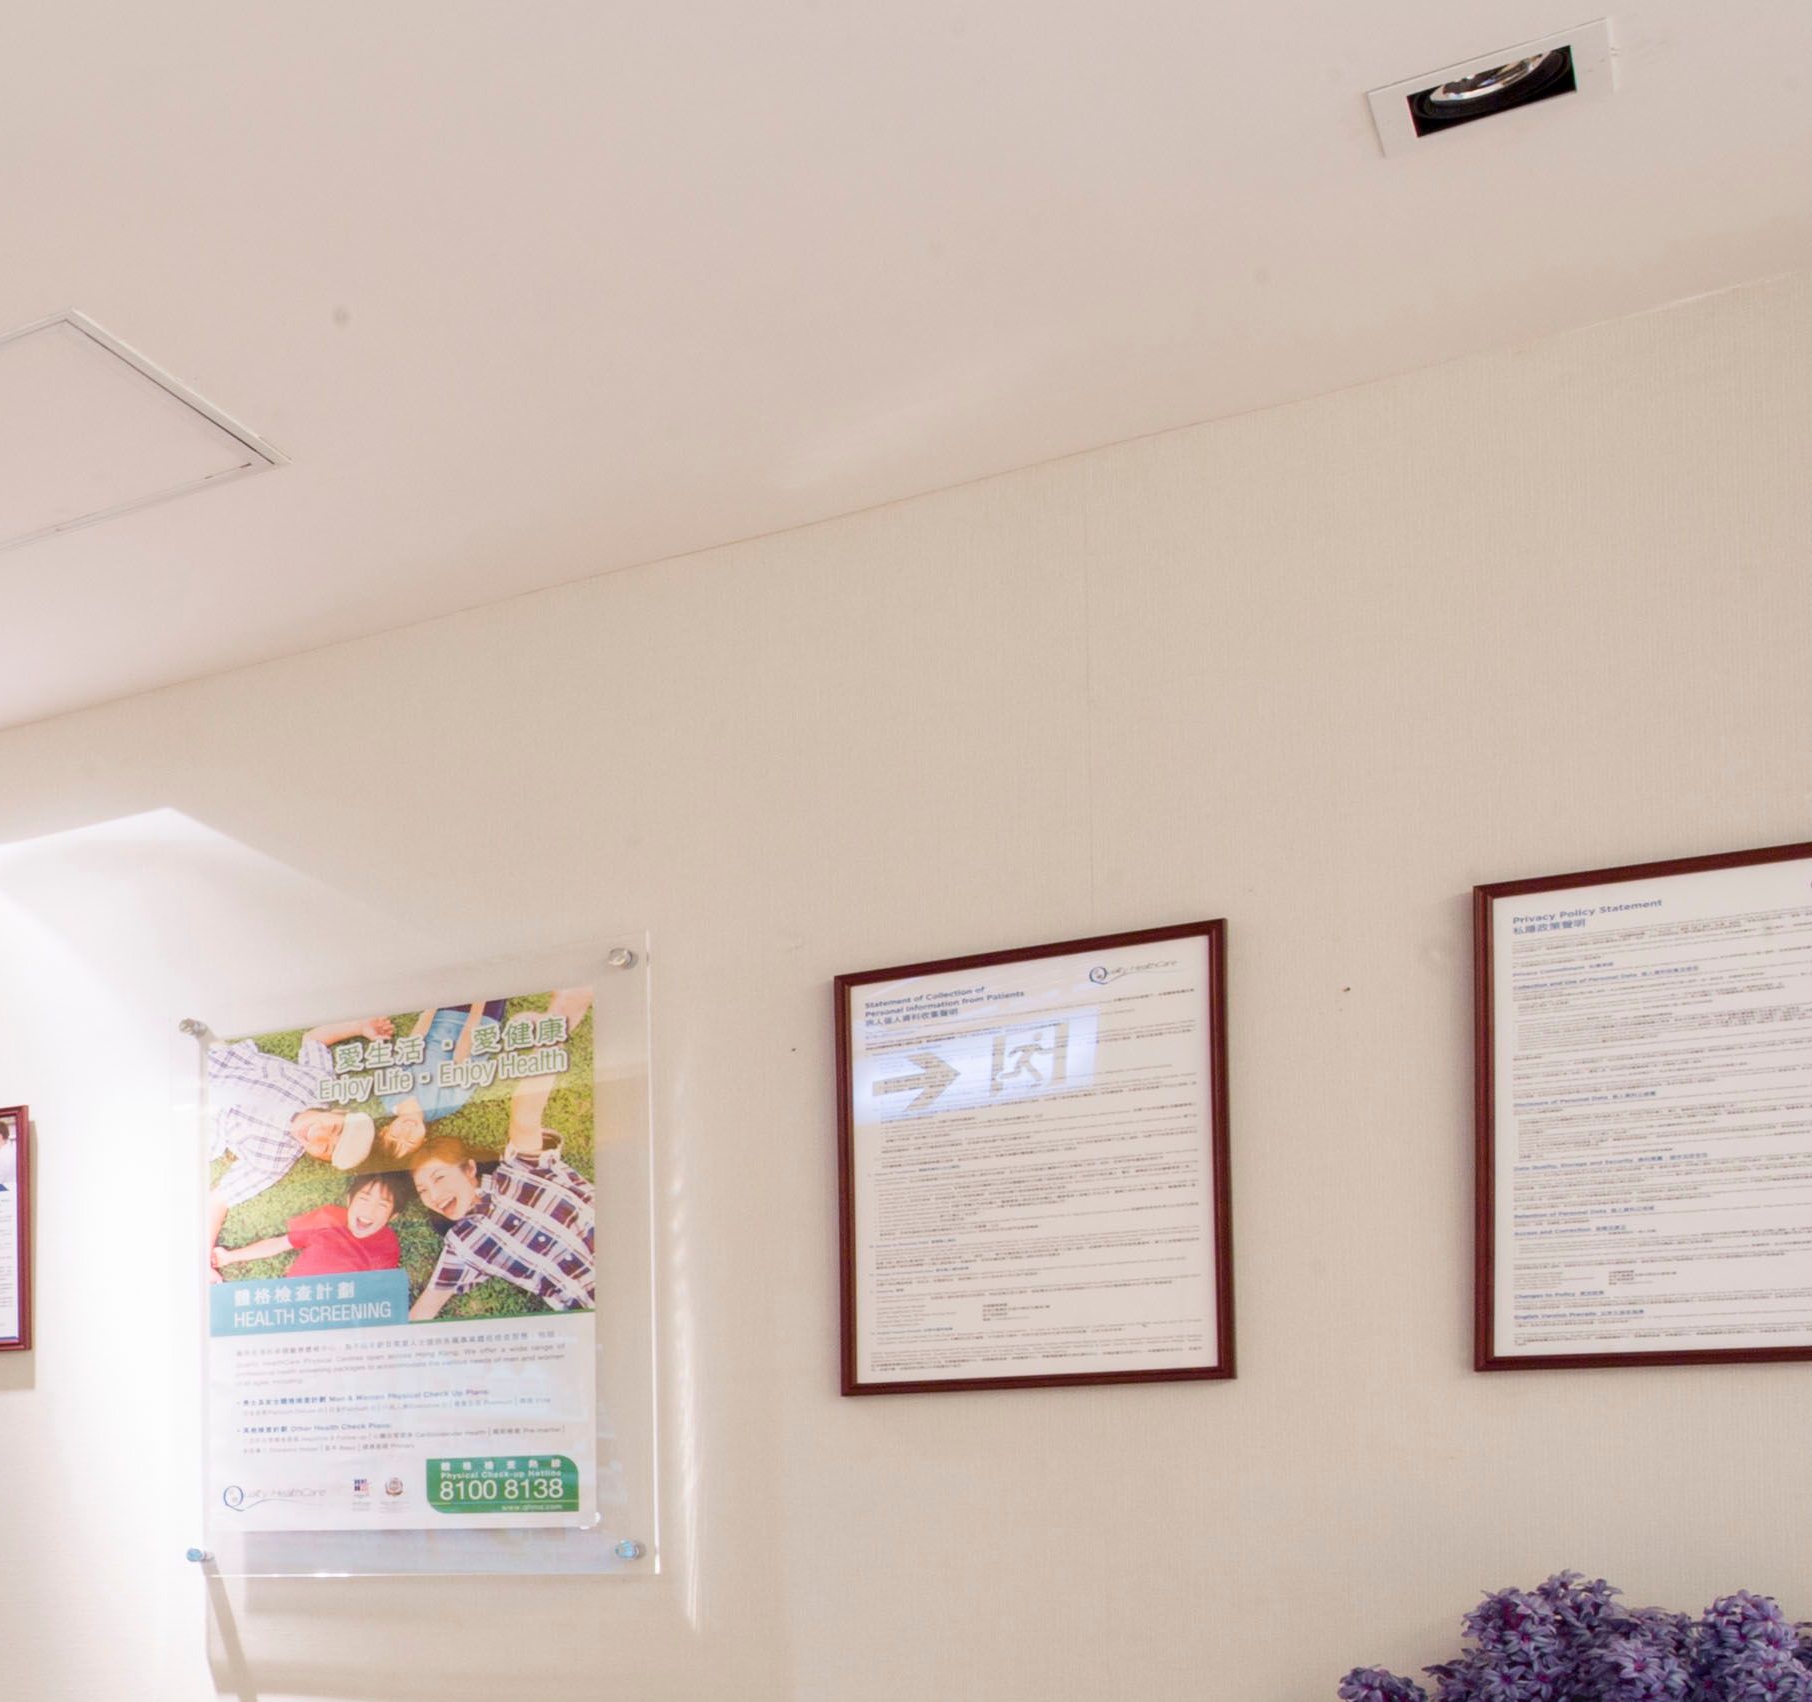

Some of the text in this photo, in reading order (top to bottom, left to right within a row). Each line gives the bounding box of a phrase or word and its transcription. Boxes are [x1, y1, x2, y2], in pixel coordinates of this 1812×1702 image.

[1513, 899, 1663, 925] Privacy Policy Statement
[865, 996, 911, 1009] Statement
[925, 988, 973, 1000] Collection
[865, 991, 1025, 1018] Personal Information from Patients
[335, 1017, 567, 1073] 愛生活 愛健康
[319, 1049, 568, 1103] Enjoy Life Enjoy Health
[234, 1281, 355, 1307] 體格檢查計劃
[234, 1302, 392, 1328] HEALTH SCREENING
[441, 1469, 561, 1480] Physical Check-up Hotline
[440, 1478, 563, 1501] 8100 8138
